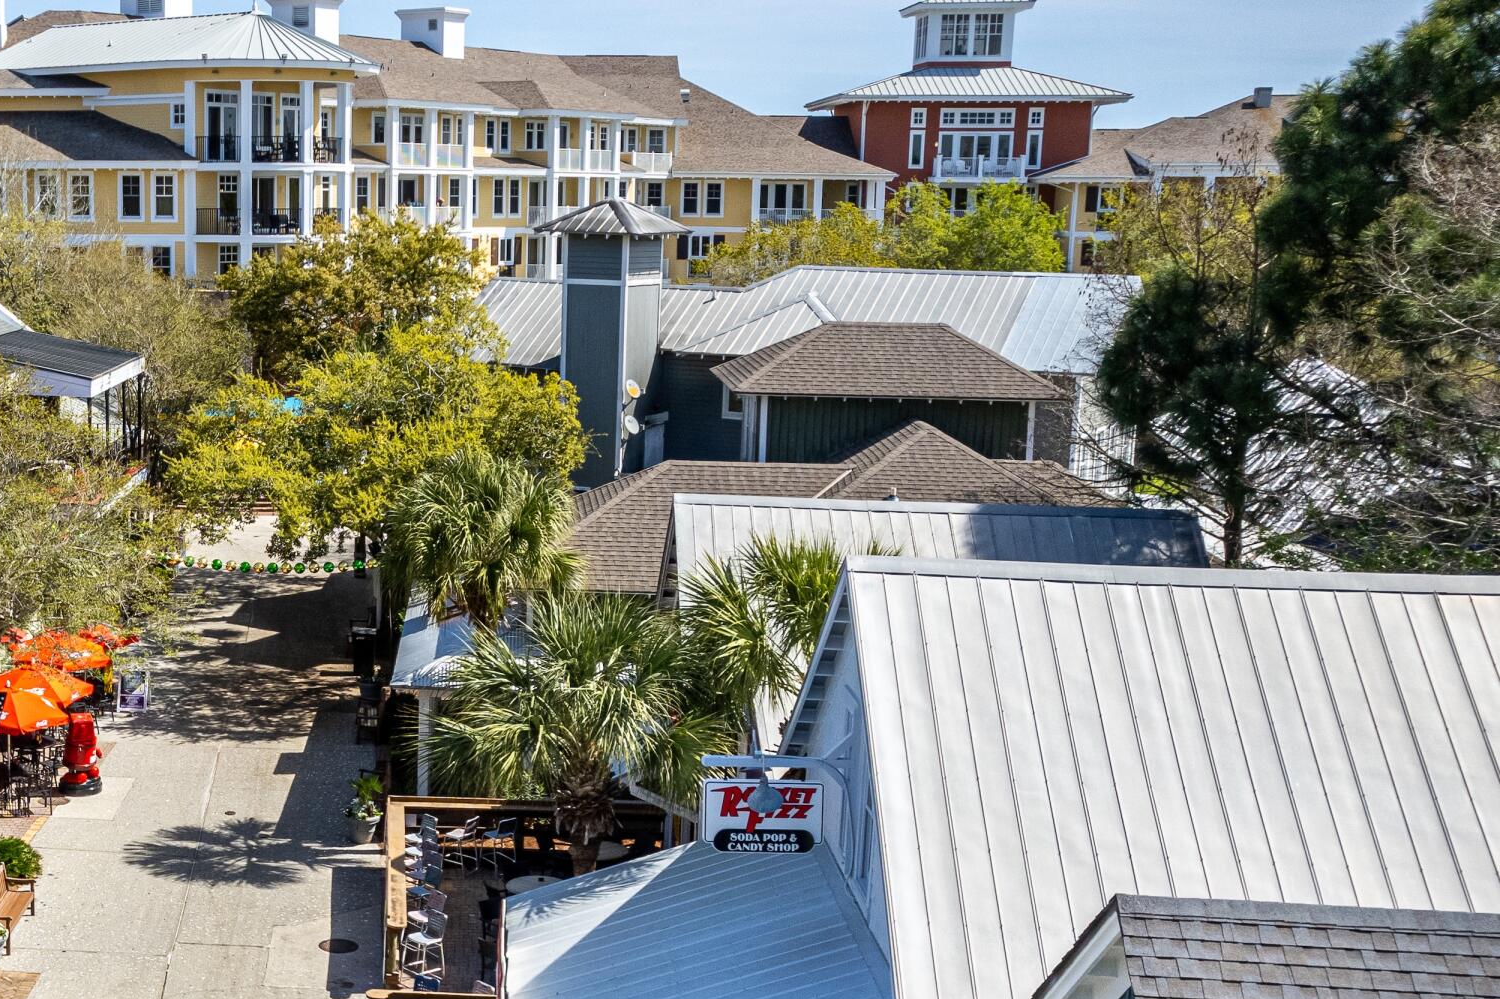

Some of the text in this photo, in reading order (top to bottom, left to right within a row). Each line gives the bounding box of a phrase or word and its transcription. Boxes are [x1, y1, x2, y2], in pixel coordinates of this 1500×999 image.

[730, 833, 798, 842] SODA POP &
[727, 842, 800, 852] CANDY SHOP
